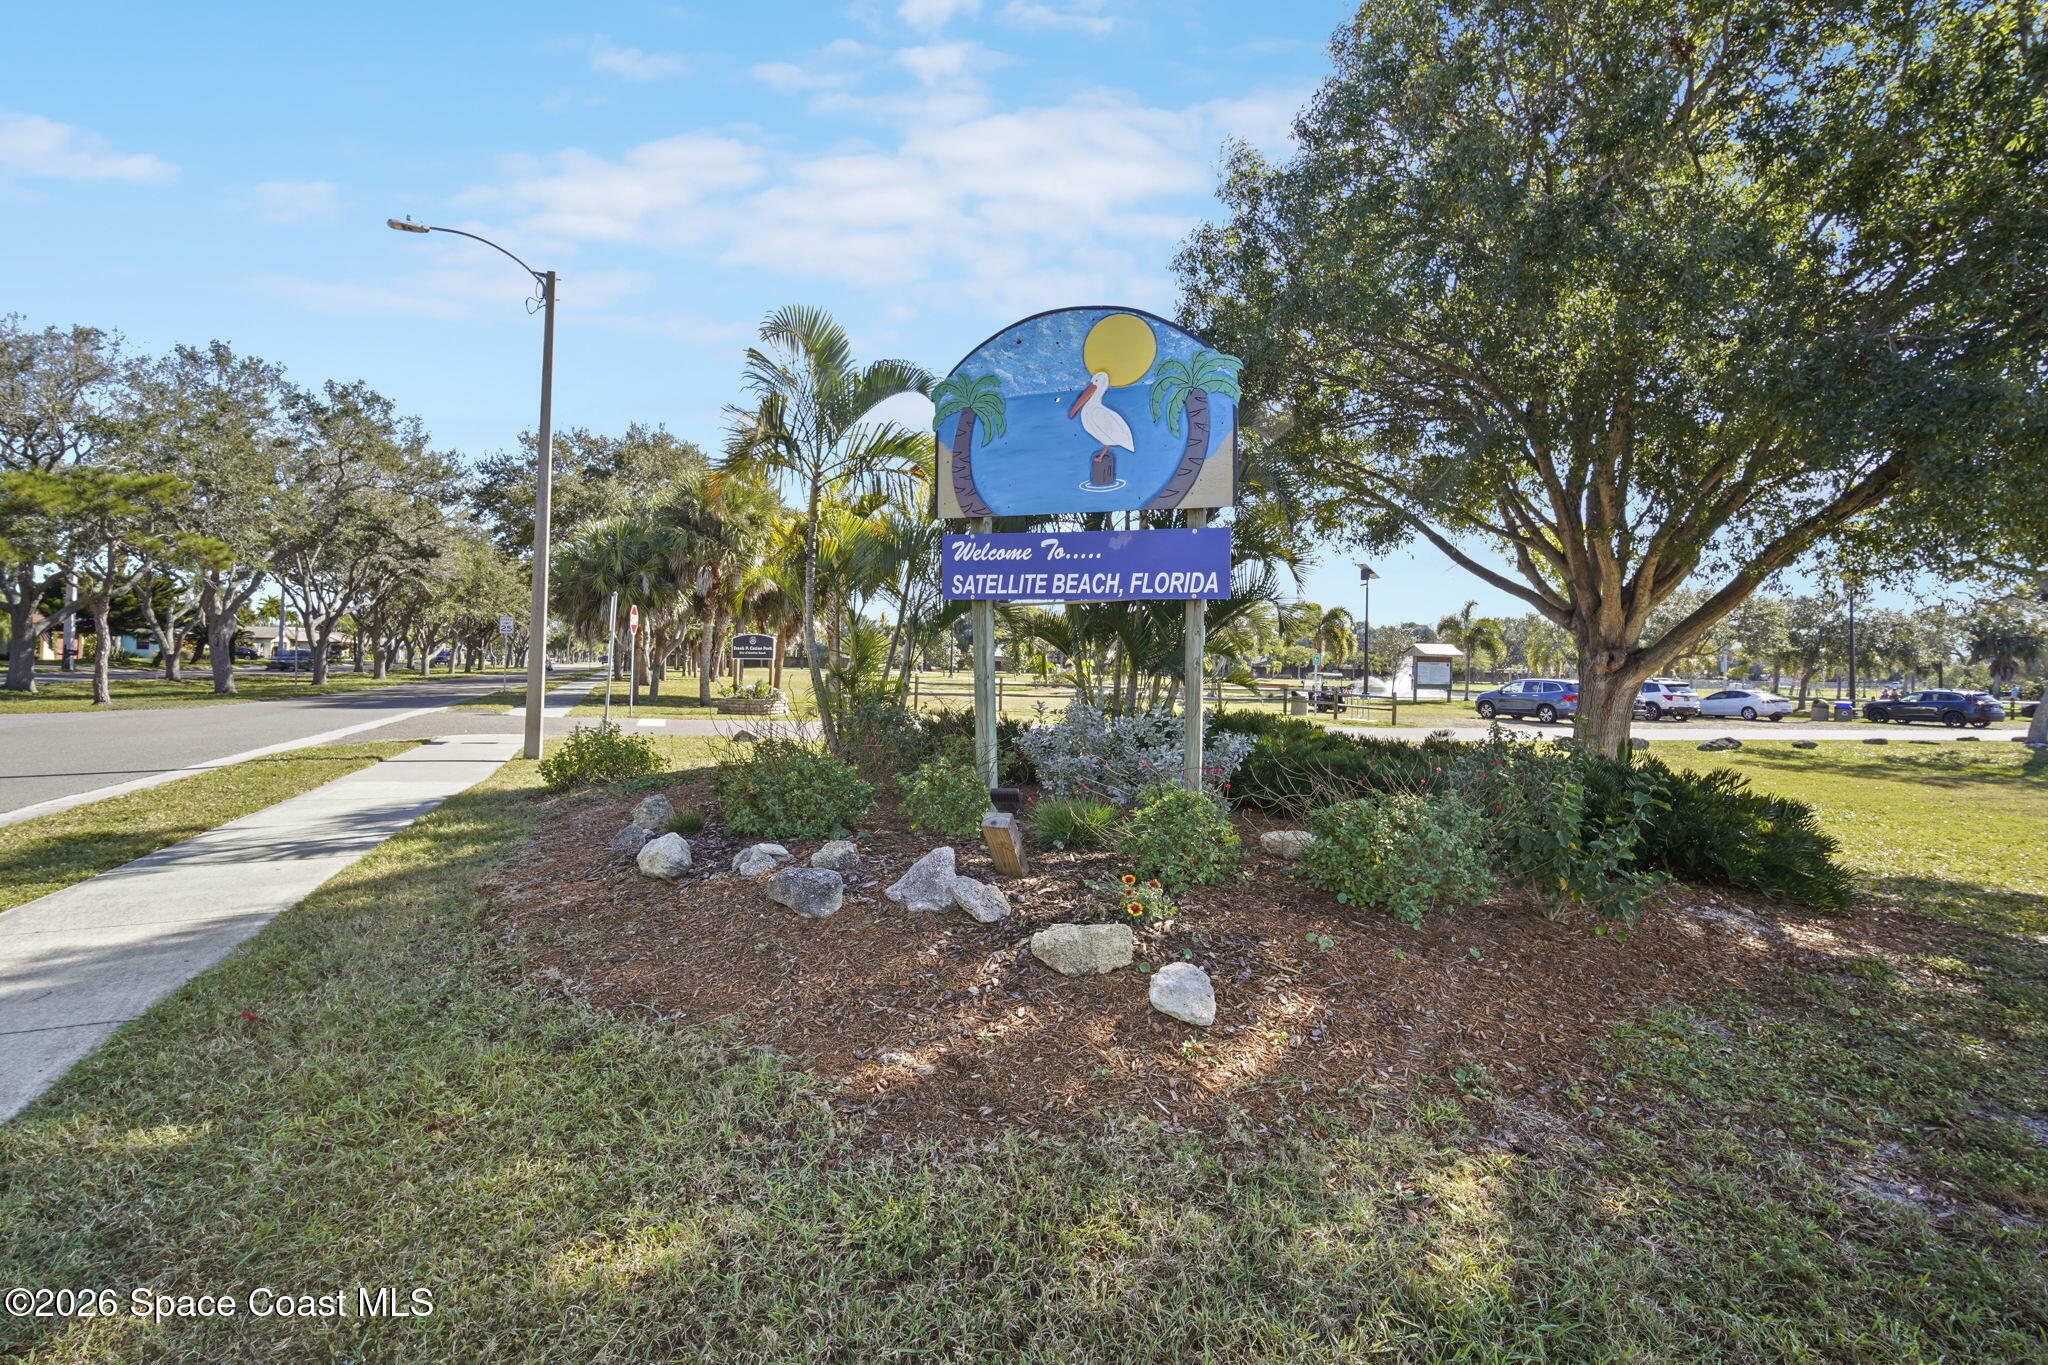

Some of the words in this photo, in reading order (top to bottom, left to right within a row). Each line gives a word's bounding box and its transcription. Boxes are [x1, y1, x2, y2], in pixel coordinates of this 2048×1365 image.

[951, 540, 1032, 562] Welcome
[951, 573, 1048, 595] SATELLITE
[1051, 572, 1124, 597] BEACH,
[1129, 571, 1219, 594] FLORIDA
